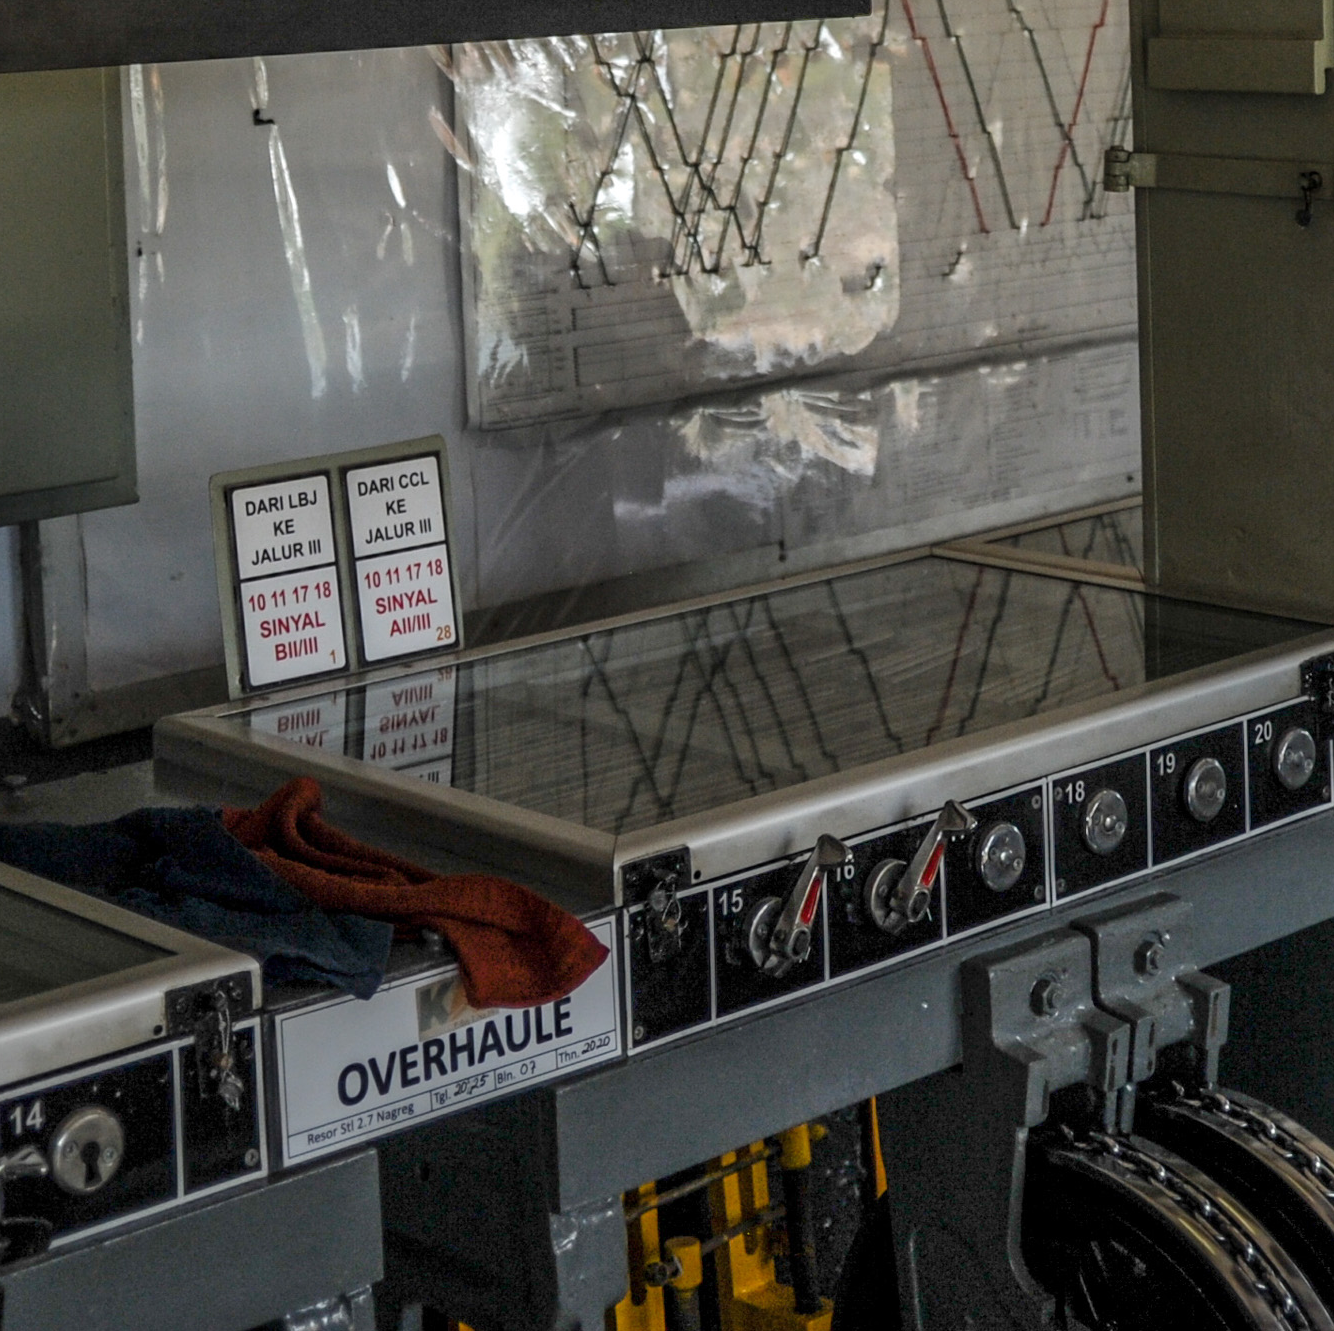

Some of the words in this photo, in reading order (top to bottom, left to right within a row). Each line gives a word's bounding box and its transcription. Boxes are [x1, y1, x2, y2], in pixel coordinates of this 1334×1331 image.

[358, 476, 394, 496] DARI
[399, 471, 429, 488] CCL
[245, 495, 284, 516] DARI
[288, 490, 317, 508] LBJ
[386, 499, 407, 515] KE
[273, 519, 295, 537] KE
[365, 521, 414, 544] JALUR
[420, 518, 432, 533] III
[252, 542, 303, 566] JALUR
[309, 539, 321, 554] III
[364, 571, 381, 590] 10
[386, 567, 400, 585] 11
[406, 562, 421, 581] 17
[427, 558, 443, 576] 18
[249, 593, 266, 612] 10
[271, 590, 286, 608] 11
[292, 585, 308, 603] 17
[315, 581, 331, 599] 18
[375, 588, 437, 614] SINYAL
[260, 611, 326, 638] SINYAL
[390, 613, 431, 637] AII/III
[436, 625, 451, 642] 28
[275, 637, 318, 662] BII/III
[1254, 721, 1273, 743] 20
[1156, 753, 1176, 776] 19
[1065, 781, 1085, 804] 18
[719, 890, 744, 916] 15
[337, 996, 574, 1107] OVERHAULE
[9, 1103, 46, 1135] 14
[307, 1125, 338, 1146] Resor
[340, 1117, 355, 1137] Stl
[376, 1102, 416, 1127] Nagreg
